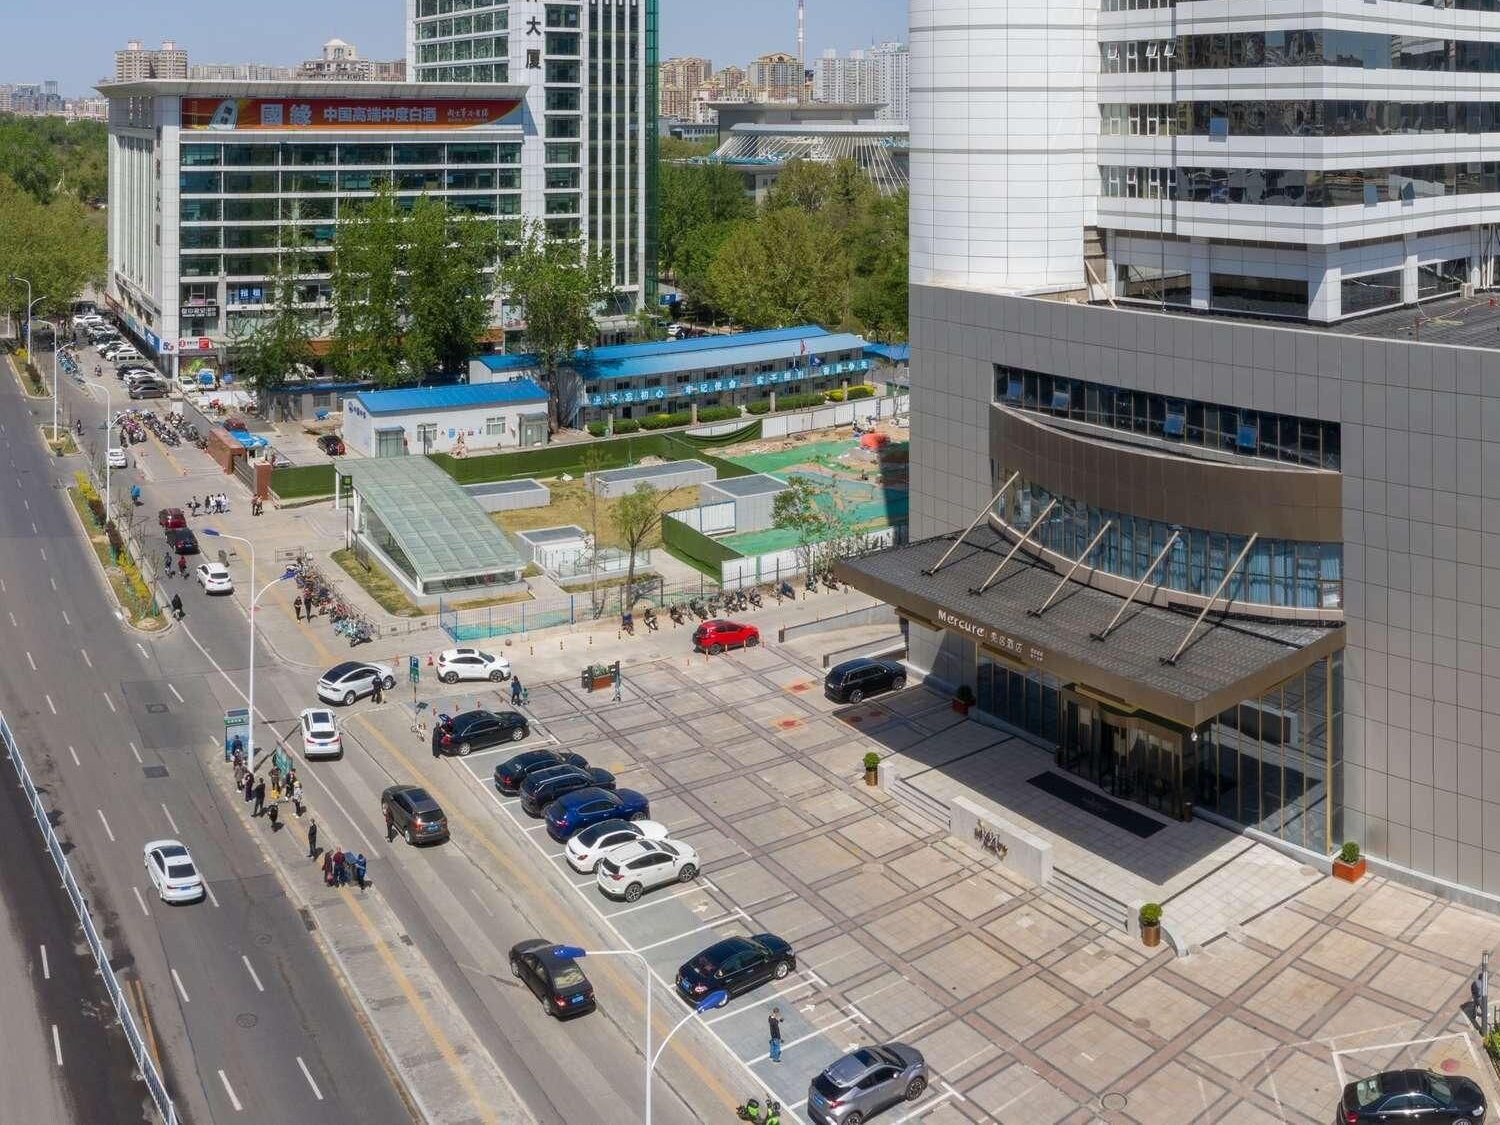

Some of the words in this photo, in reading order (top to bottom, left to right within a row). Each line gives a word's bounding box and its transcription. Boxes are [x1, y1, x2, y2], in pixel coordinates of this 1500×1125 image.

[323, 106, 437, 123] 中国高端中度白酒
[610, 390, 664, 402] 不忘初心
[685, 379, 736, 395] 牢记使命
[938, 609, 985, 636] Mercure
